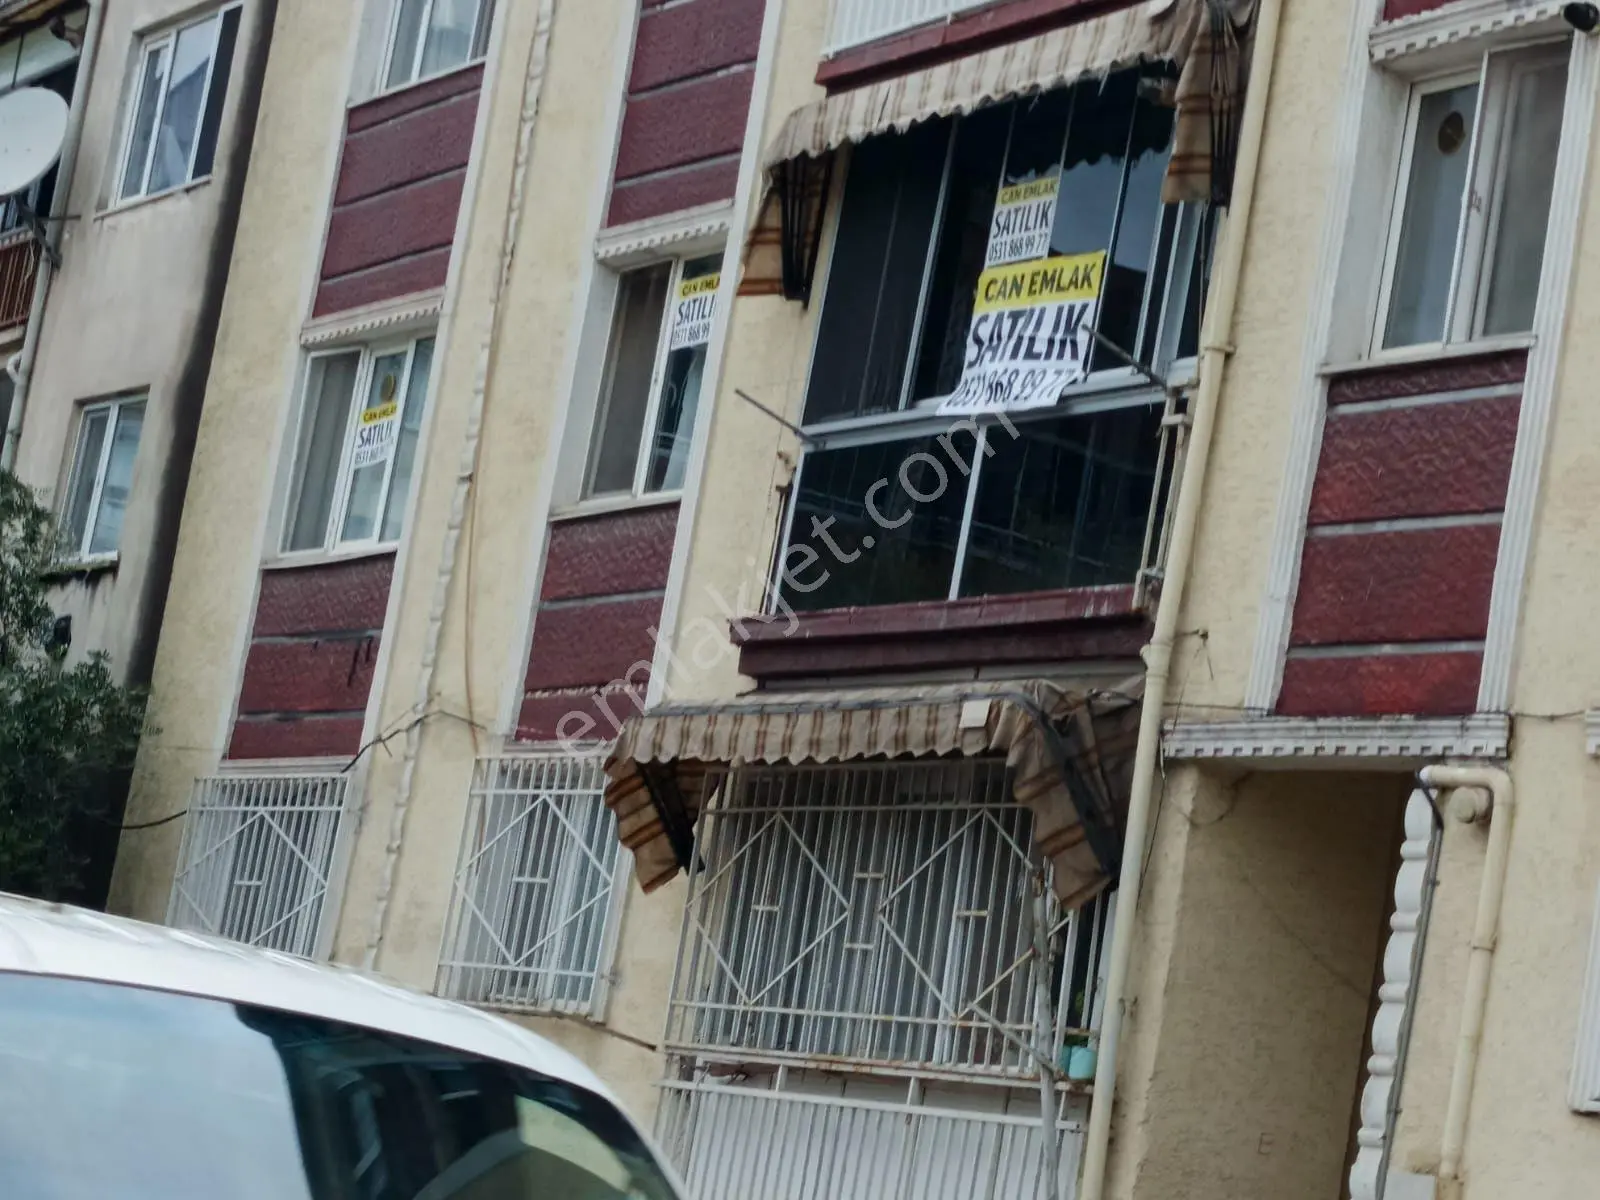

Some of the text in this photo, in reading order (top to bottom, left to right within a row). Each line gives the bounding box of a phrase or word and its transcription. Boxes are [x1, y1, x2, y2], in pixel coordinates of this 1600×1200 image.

[1001, 182, 1056, 205] CAN EMLAK
[993, 200, 1052, 239] SATILIK
[985, 263, 1096, 302] CAN EMLAK
[966, 302, 1089, 369] SATILIK
